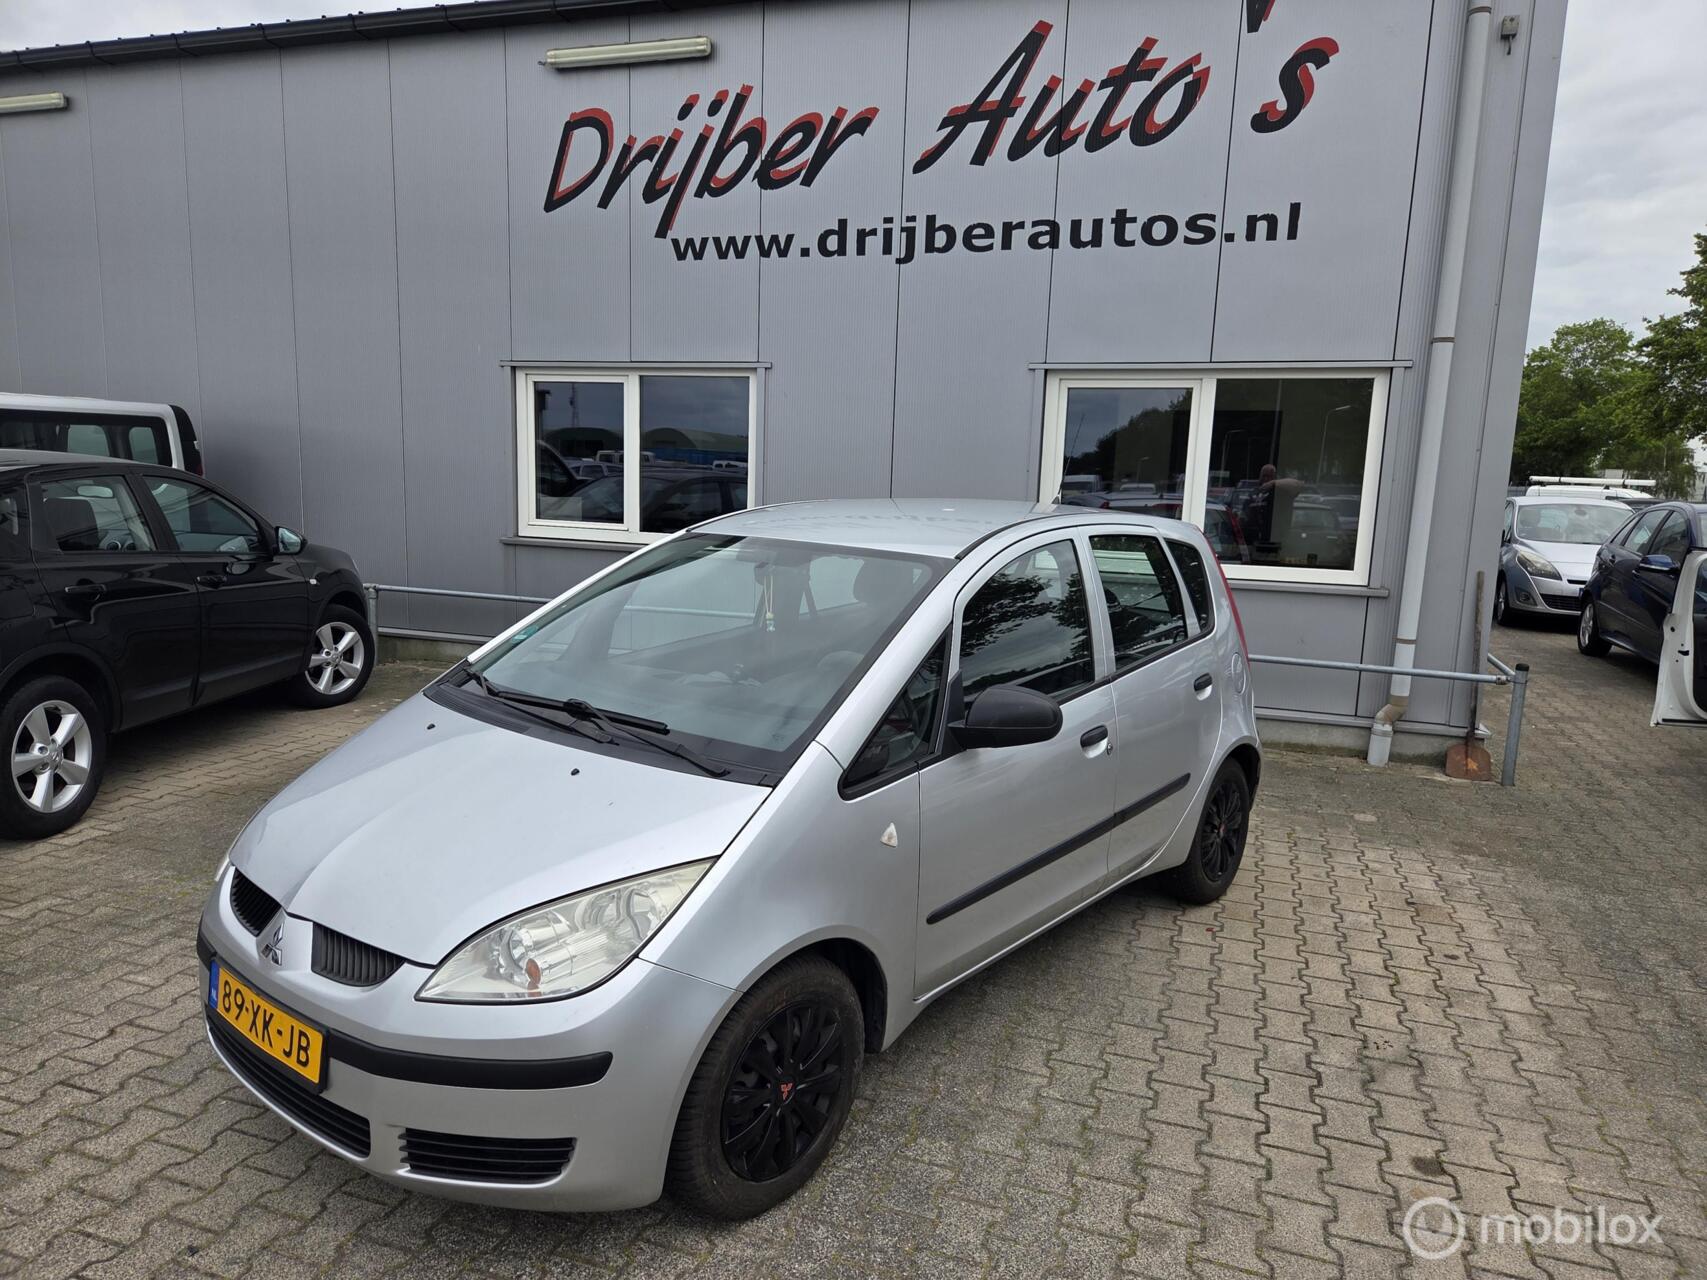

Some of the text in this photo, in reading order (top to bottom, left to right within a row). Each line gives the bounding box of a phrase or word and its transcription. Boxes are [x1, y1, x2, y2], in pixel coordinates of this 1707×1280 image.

[543, 0, 1340, 240] Drijber Auto's
[670, 203, 1301, 264] www.drijberautos.nl
[222, 980, 310, 1068] 89-XK-JB
